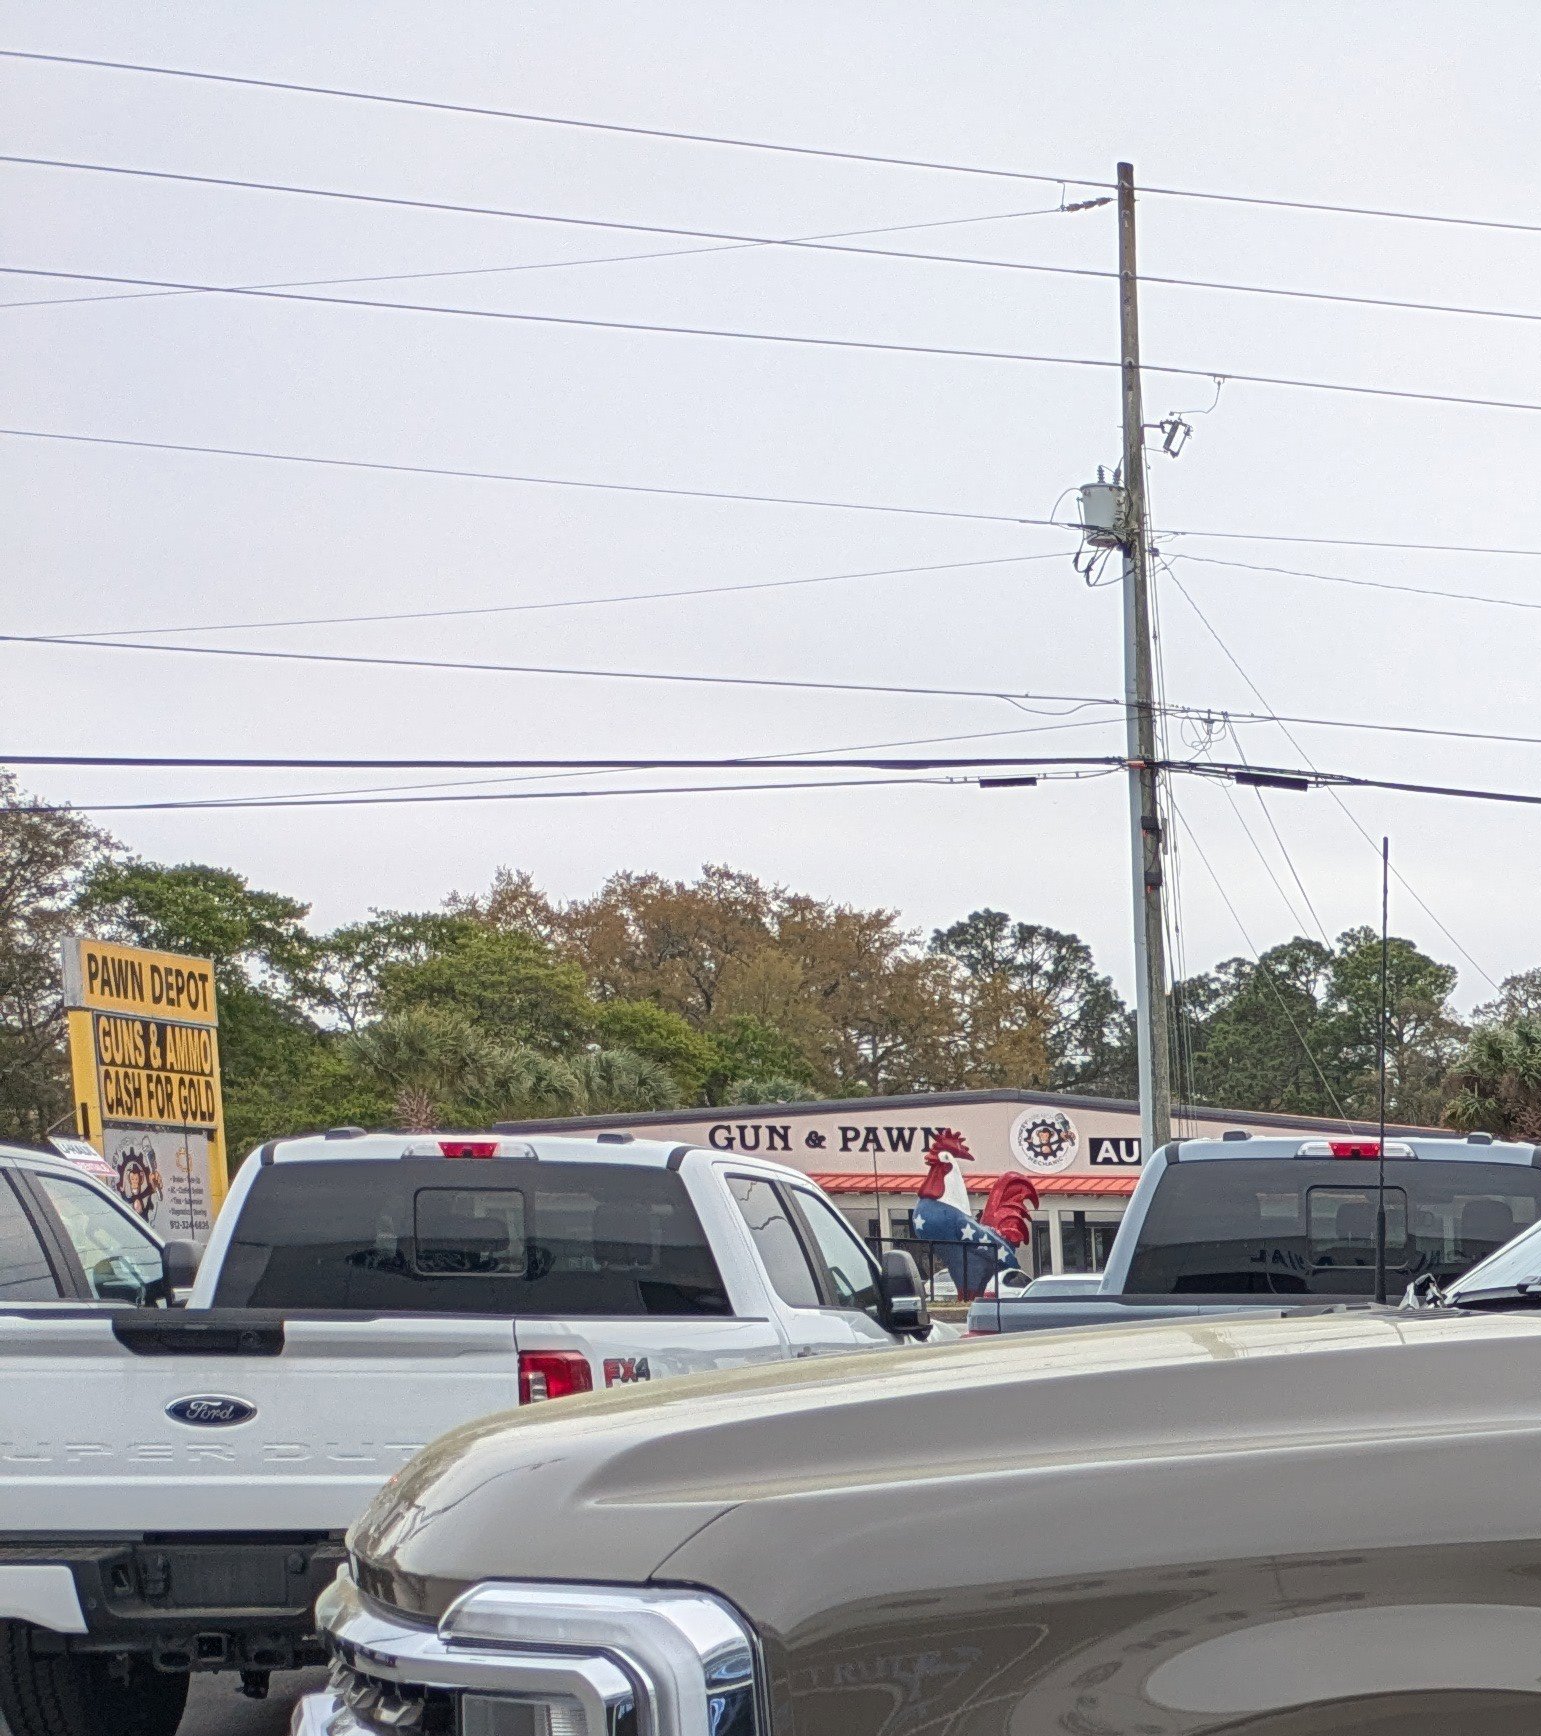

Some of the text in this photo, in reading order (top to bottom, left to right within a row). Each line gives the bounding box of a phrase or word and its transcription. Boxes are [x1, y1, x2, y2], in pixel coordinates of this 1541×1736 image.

[87, 953, 208, 1012] PAWN DEPOT
[99, 1016, 212, 1075] GUNS & AMMO
[103, 1068, 215, 1122] CASH FOR GOLD
[708, 1124, 946, 1152] GUN & PAWN
[603, 1357, 651, 1389] FX4
[184, 1400, 235, 1421] Ford
